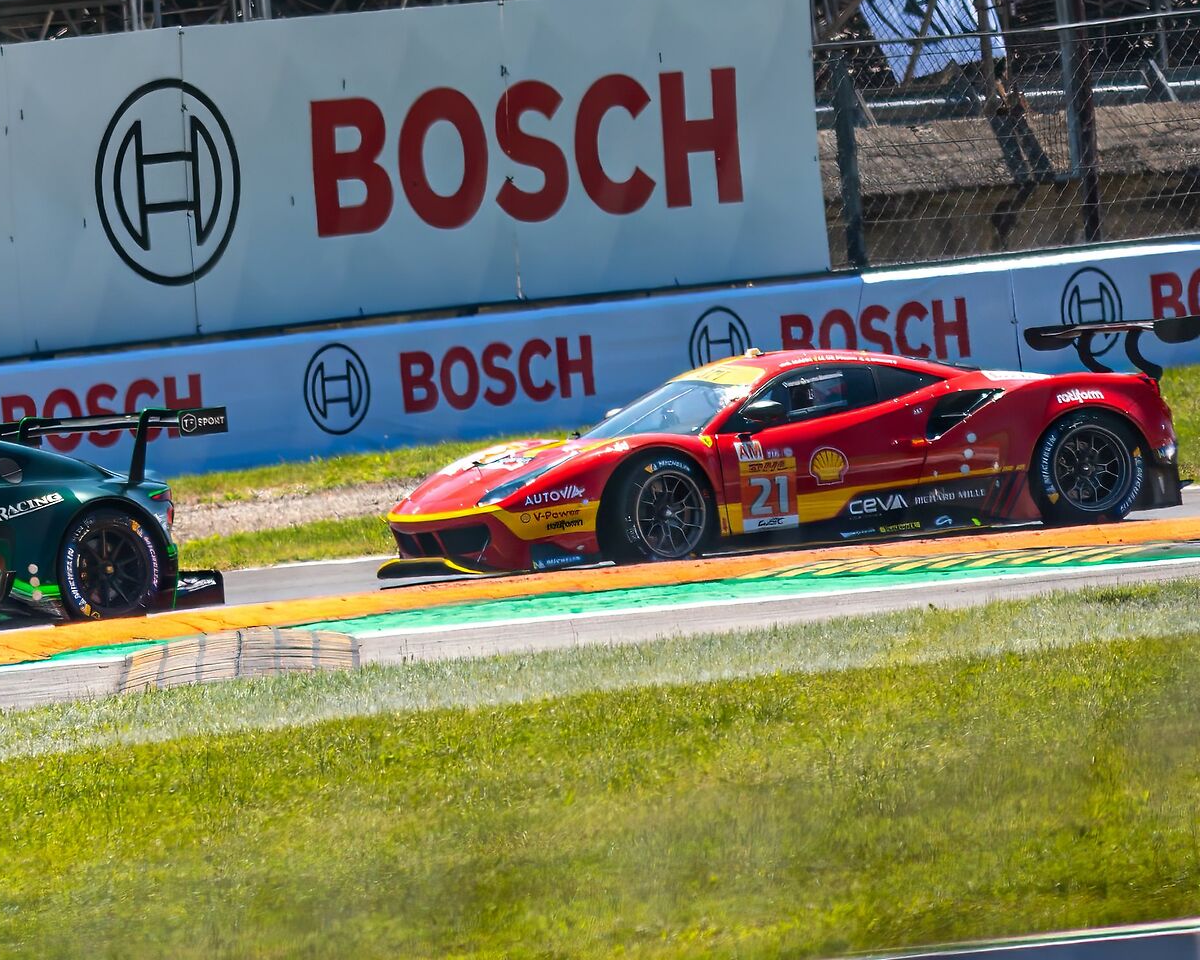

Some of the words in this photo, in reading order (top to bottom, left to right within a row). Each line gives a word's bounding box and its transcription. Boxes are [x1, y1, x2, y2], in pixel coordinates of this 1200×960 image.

[310, 67, 744, 237] BOSCH
[400, 335, 596, 414] BOSCH
[749, 475, 790, 516] 21
